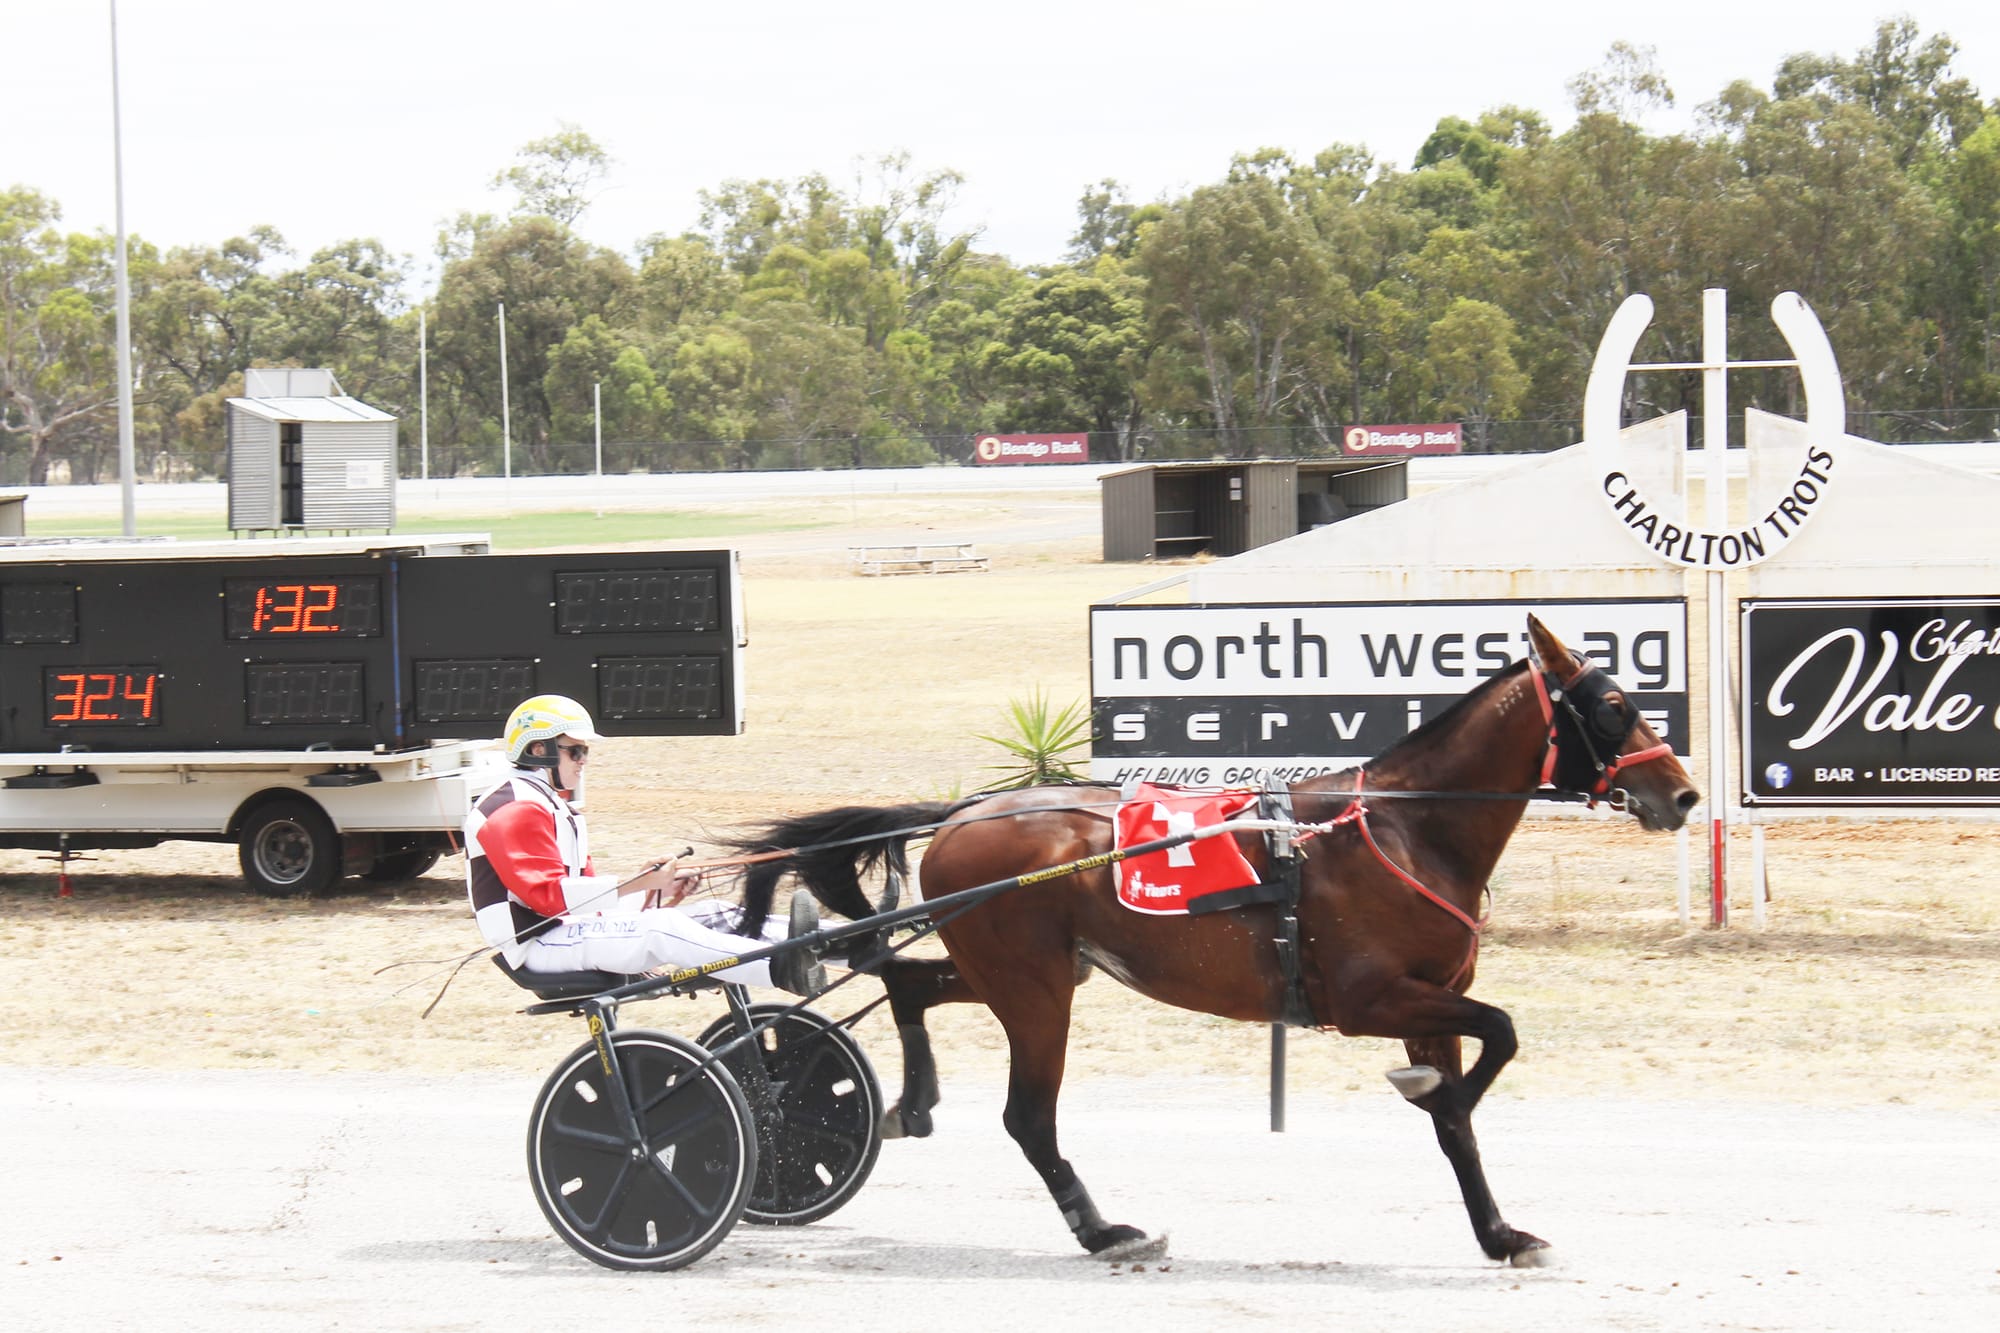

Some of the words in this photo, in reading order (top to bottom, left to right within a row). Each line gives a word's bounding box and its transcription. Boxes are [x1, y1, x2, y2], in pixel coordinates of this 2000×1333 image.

[1001, 442, 1049, 457] Bendigo
[1051, 440, 1083, 454] Bank
[1370, 431, 1422, 449] Bendigo
[1423, 430, 1457, 445] Bank
[1604, 471, 1765, 565] CHARLTON
[1764, 446, 1833, 539] TROTS
[1113, 618, 1328, 681] north
[1361, 632, 1531, 678] wes
[1910, 618, 2000, 662] Charl
[1767, 627, 1985, 750] Vale
[1814, 768, 1854, 783] BAR
[1880, 767, 1972, 783] LICENSED
[1975, 767, 2000, 783] RE
[671, 968, 699, 983] Luke
[702, 956, 739, 974] Dunne
